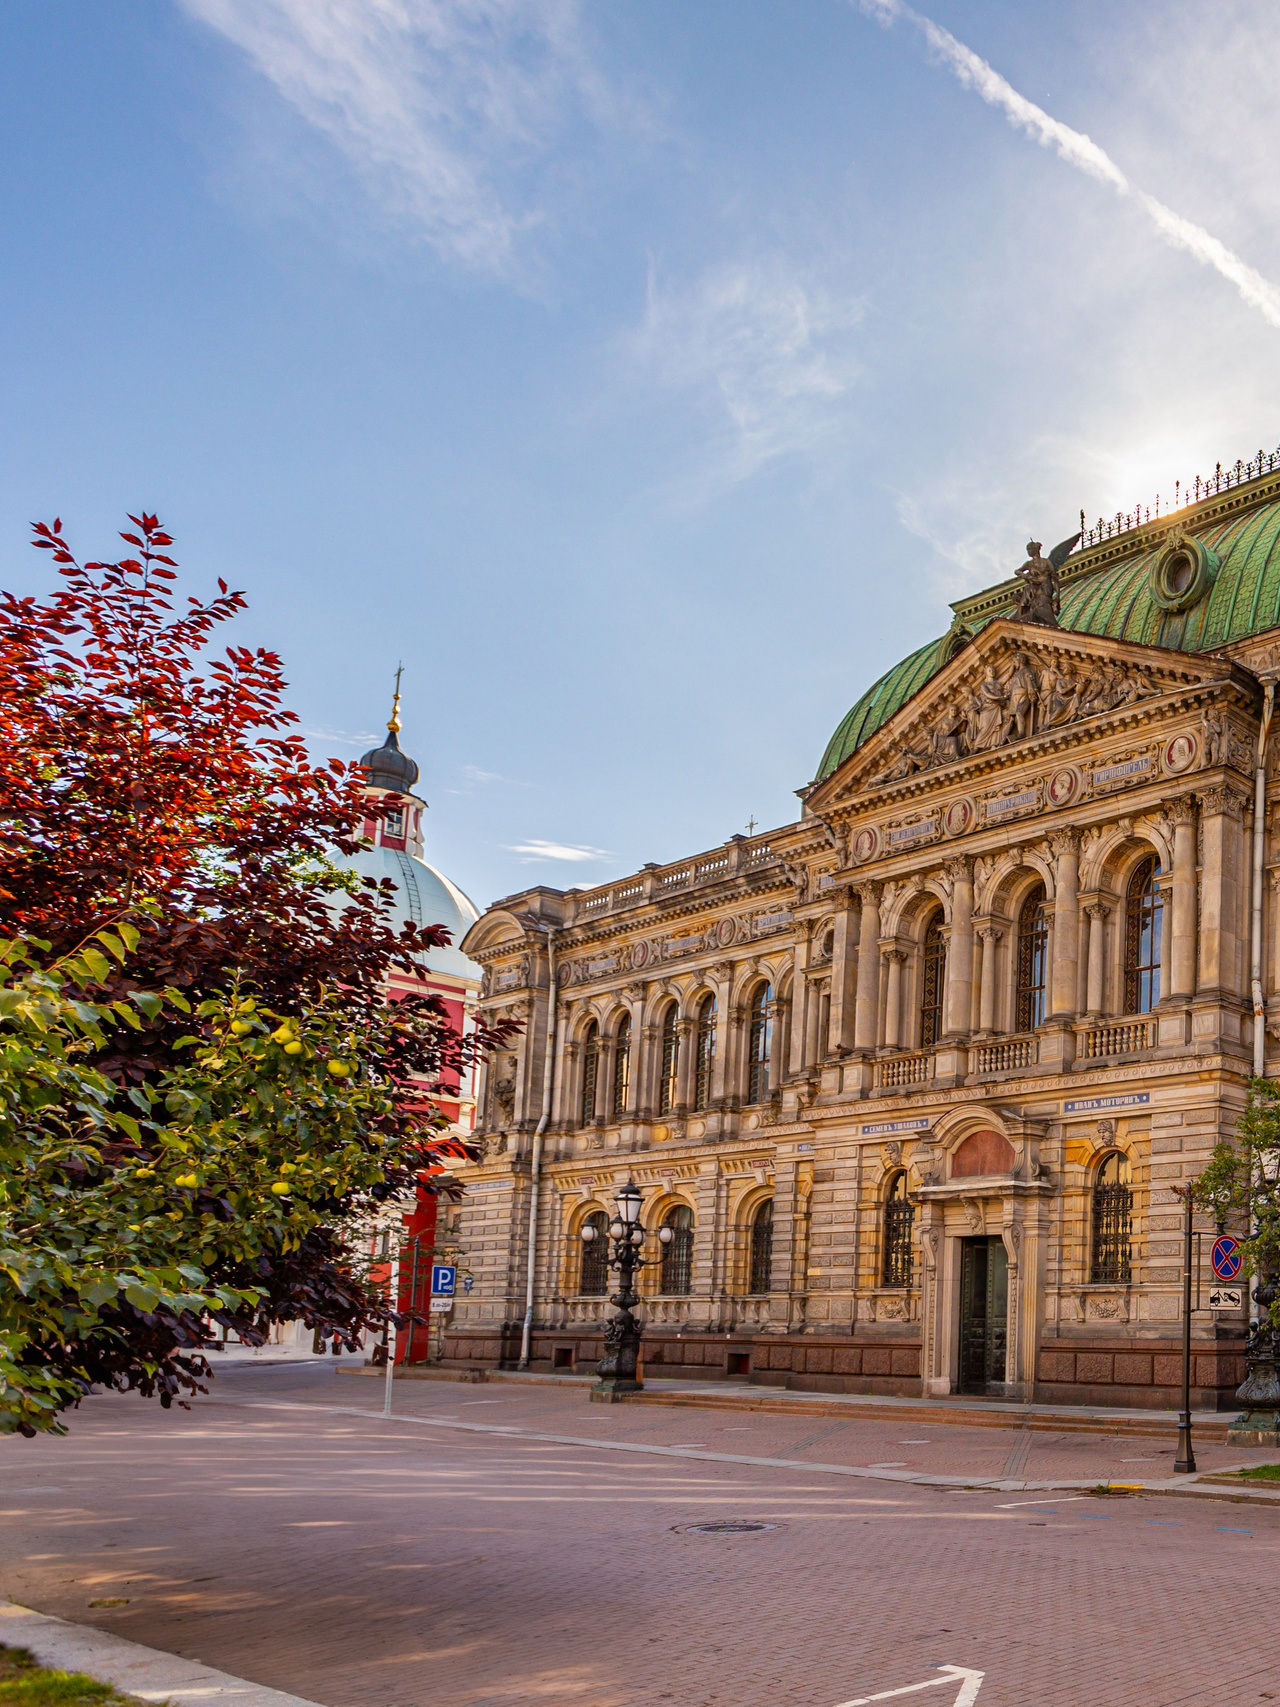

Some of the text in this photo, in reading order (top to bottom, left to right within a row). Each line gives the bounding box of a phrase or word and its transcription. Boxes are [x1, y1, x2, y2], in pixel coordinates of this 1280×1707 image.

[1074, 1095, 1140, 1110] ИВАНЪ МОТОРИНЪ
[869, 1124, 893, 1133] СЕМЕНЪ
